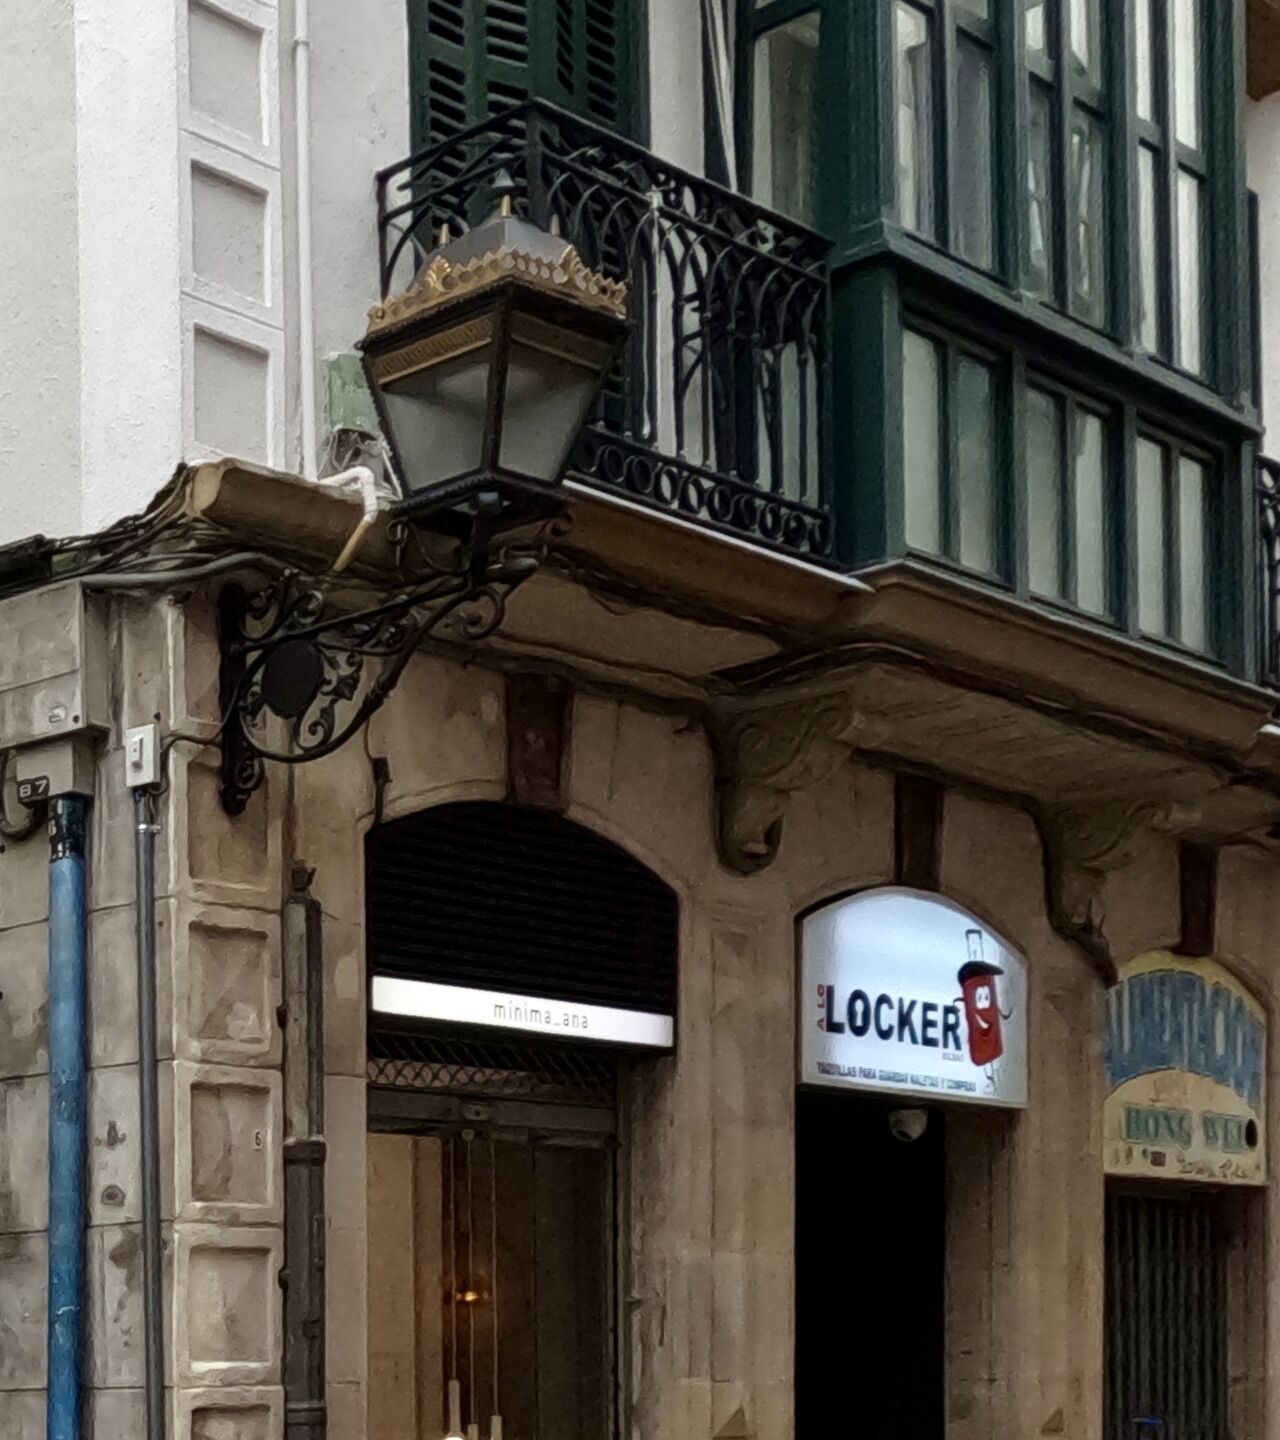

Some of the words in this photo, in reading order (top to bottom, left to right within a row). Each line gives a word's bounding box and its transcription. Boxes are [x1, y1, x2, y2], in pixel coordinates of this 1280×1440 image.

[19, 780, 48, 798] 87
[493, 1000, 589, 1030] minima_ana
[826, 984, 962, 1051] LOCKER
